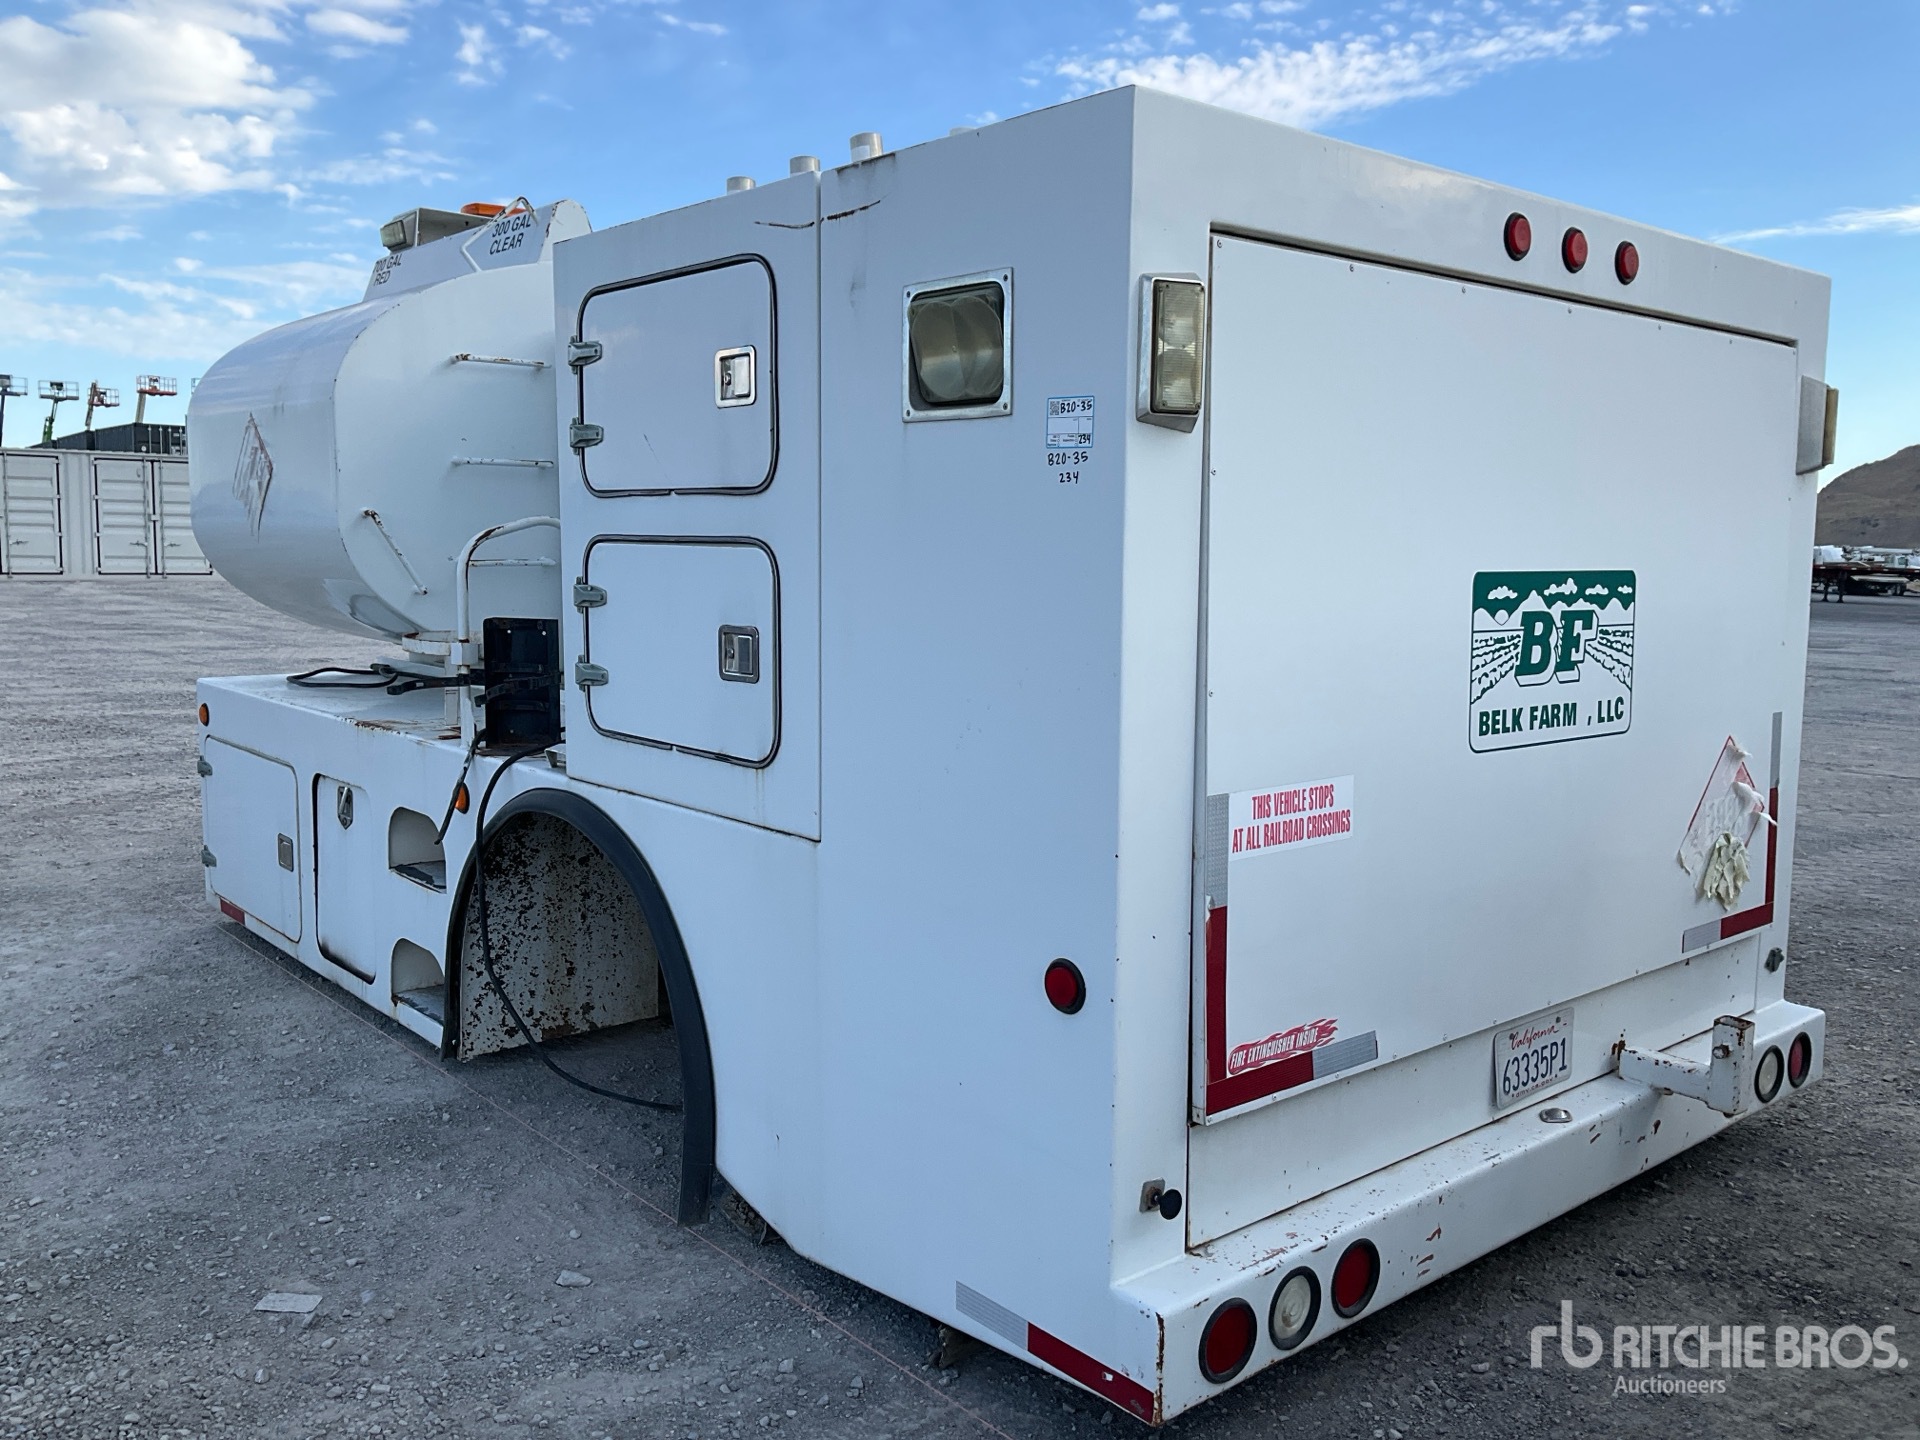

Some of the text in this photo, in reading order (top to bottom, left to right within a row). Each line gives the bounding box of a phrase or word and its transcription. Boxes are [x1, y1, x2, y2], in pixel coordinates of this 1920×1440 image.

[492, 214, 531, 237] 300 GAL
[489, 232, 524, 256] CLEAR
[387, 254, 403, 269] GAL
[373, 270, 391, 286] RED
[1078, 434, 1091, 444] 234
[1059, 470, 1079, 484] 234
[1514, 610, 1599, 687] BF
[1479, 707, 1523, 736] BELK
[1529, 702, 1577, 730] FARM
[1252, 784, 1334, 820] THIS VEHICLE STOPS
[1232, 809, 1351, 853] AT ALL RAILROAD CROSSINGS
[1230, 1027, 1319, 1069] FIRE EXTINGUISHER INSIDE
[1510, 1024, 1560, 1050] California
[1503, 1037, 1567, 1096] 63335P1
